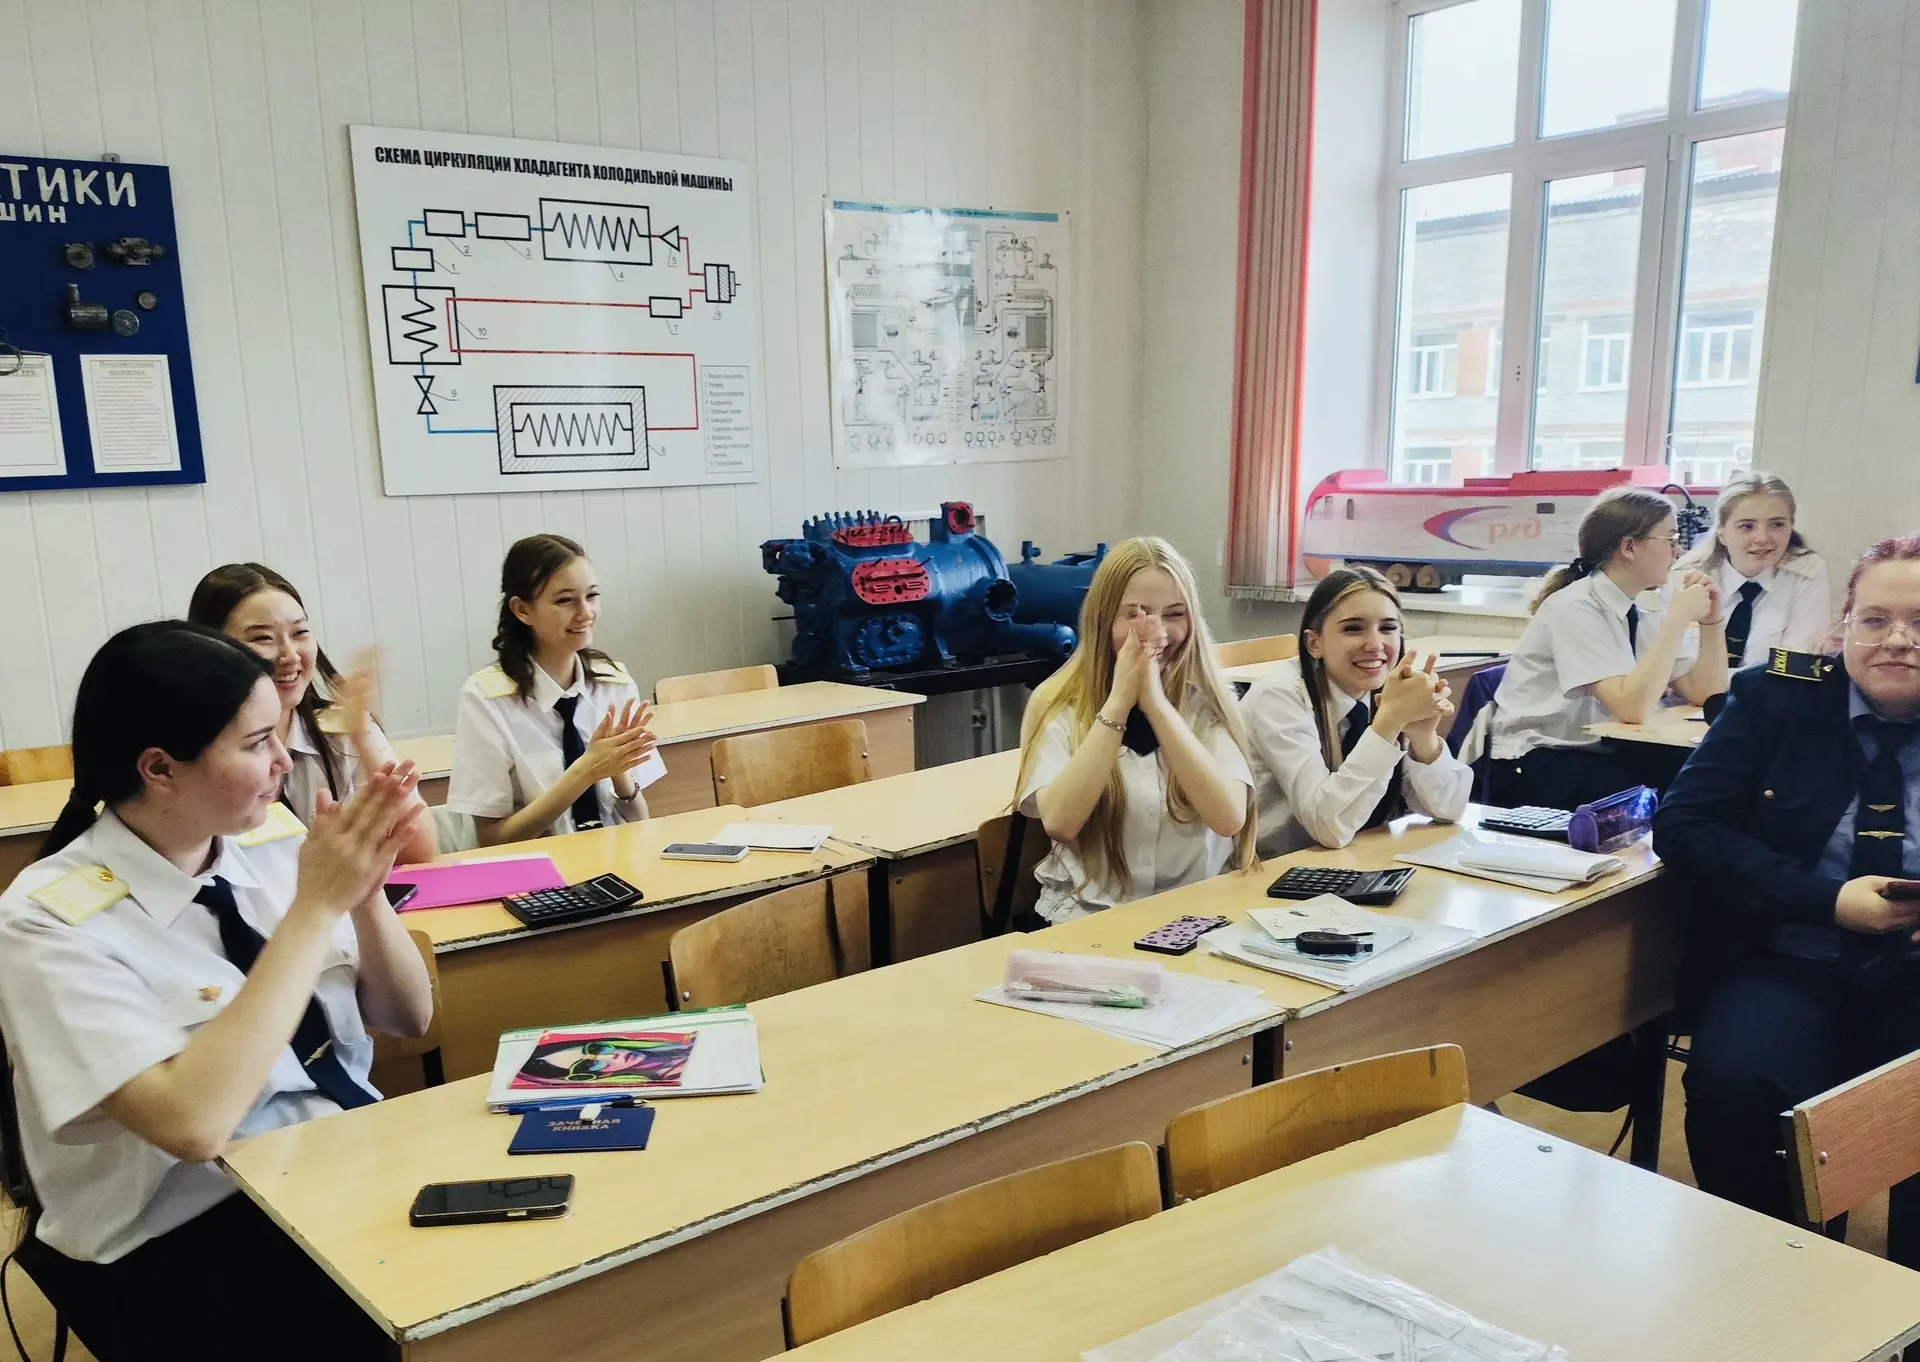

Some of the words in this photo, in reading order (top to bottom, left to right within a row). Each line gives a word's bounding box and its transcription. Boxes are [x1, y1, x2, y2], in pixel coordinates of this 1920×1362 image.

[375, 146, 421, 165] СХЕМА
[424, 150, 511, 173] ЦИРКУЛЯЦИИ
[514, 157, 591, 179] ХЛАДАГЕНТА
[593, 164, 679, 187] ХОЛОДИЛЬНОЙ
[681, 173, 733, 192] МАШИНЫ
[0, 163, 137, 207] ТИКИ
[546, 1118, 621, 1127] ЗАЧЕНАЯ
[552, 1124, 610, 1133] КНИЖКА
